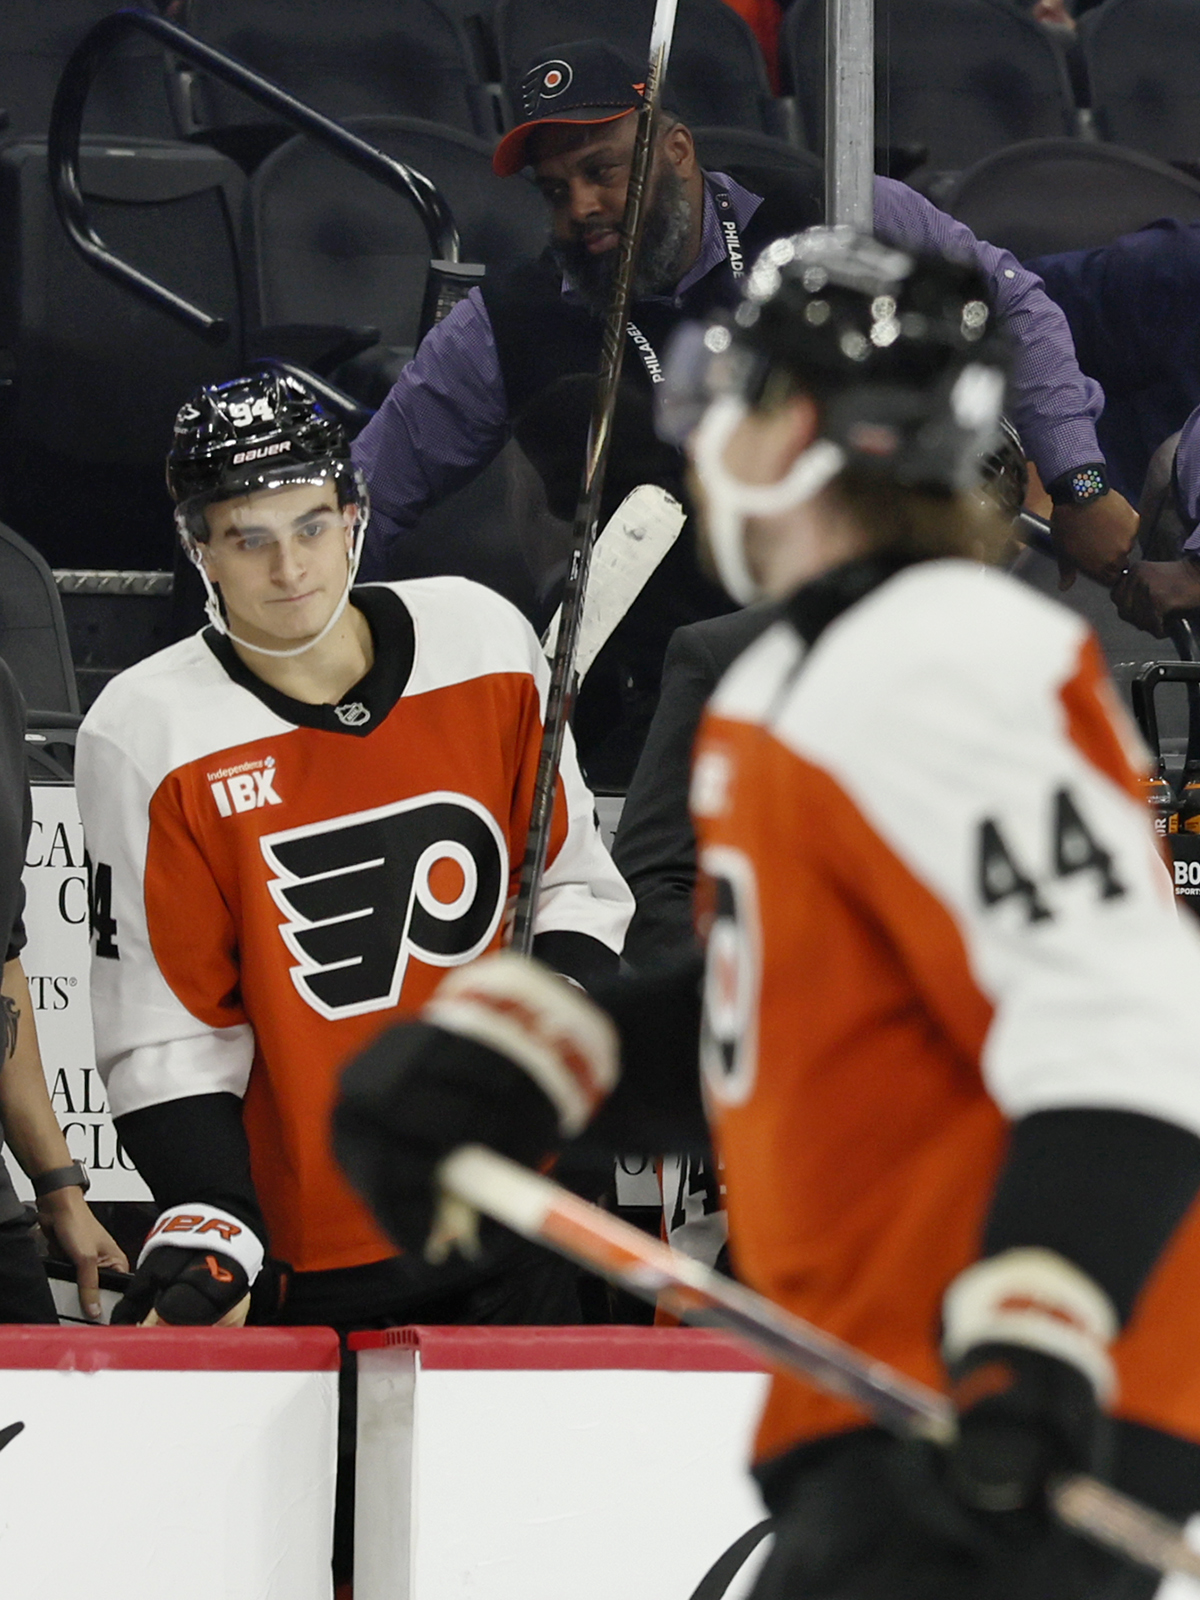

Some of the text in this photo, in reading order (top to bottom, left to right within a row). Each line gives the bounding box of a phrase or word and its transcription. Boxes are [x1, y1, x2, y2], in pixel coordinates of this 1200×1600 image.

[228, 397, 275, 428] 94
[232, 440, 292, 465] BAUER
[210, 767, 283, 818] IBX
[978, 786, 1126, 925] 44
